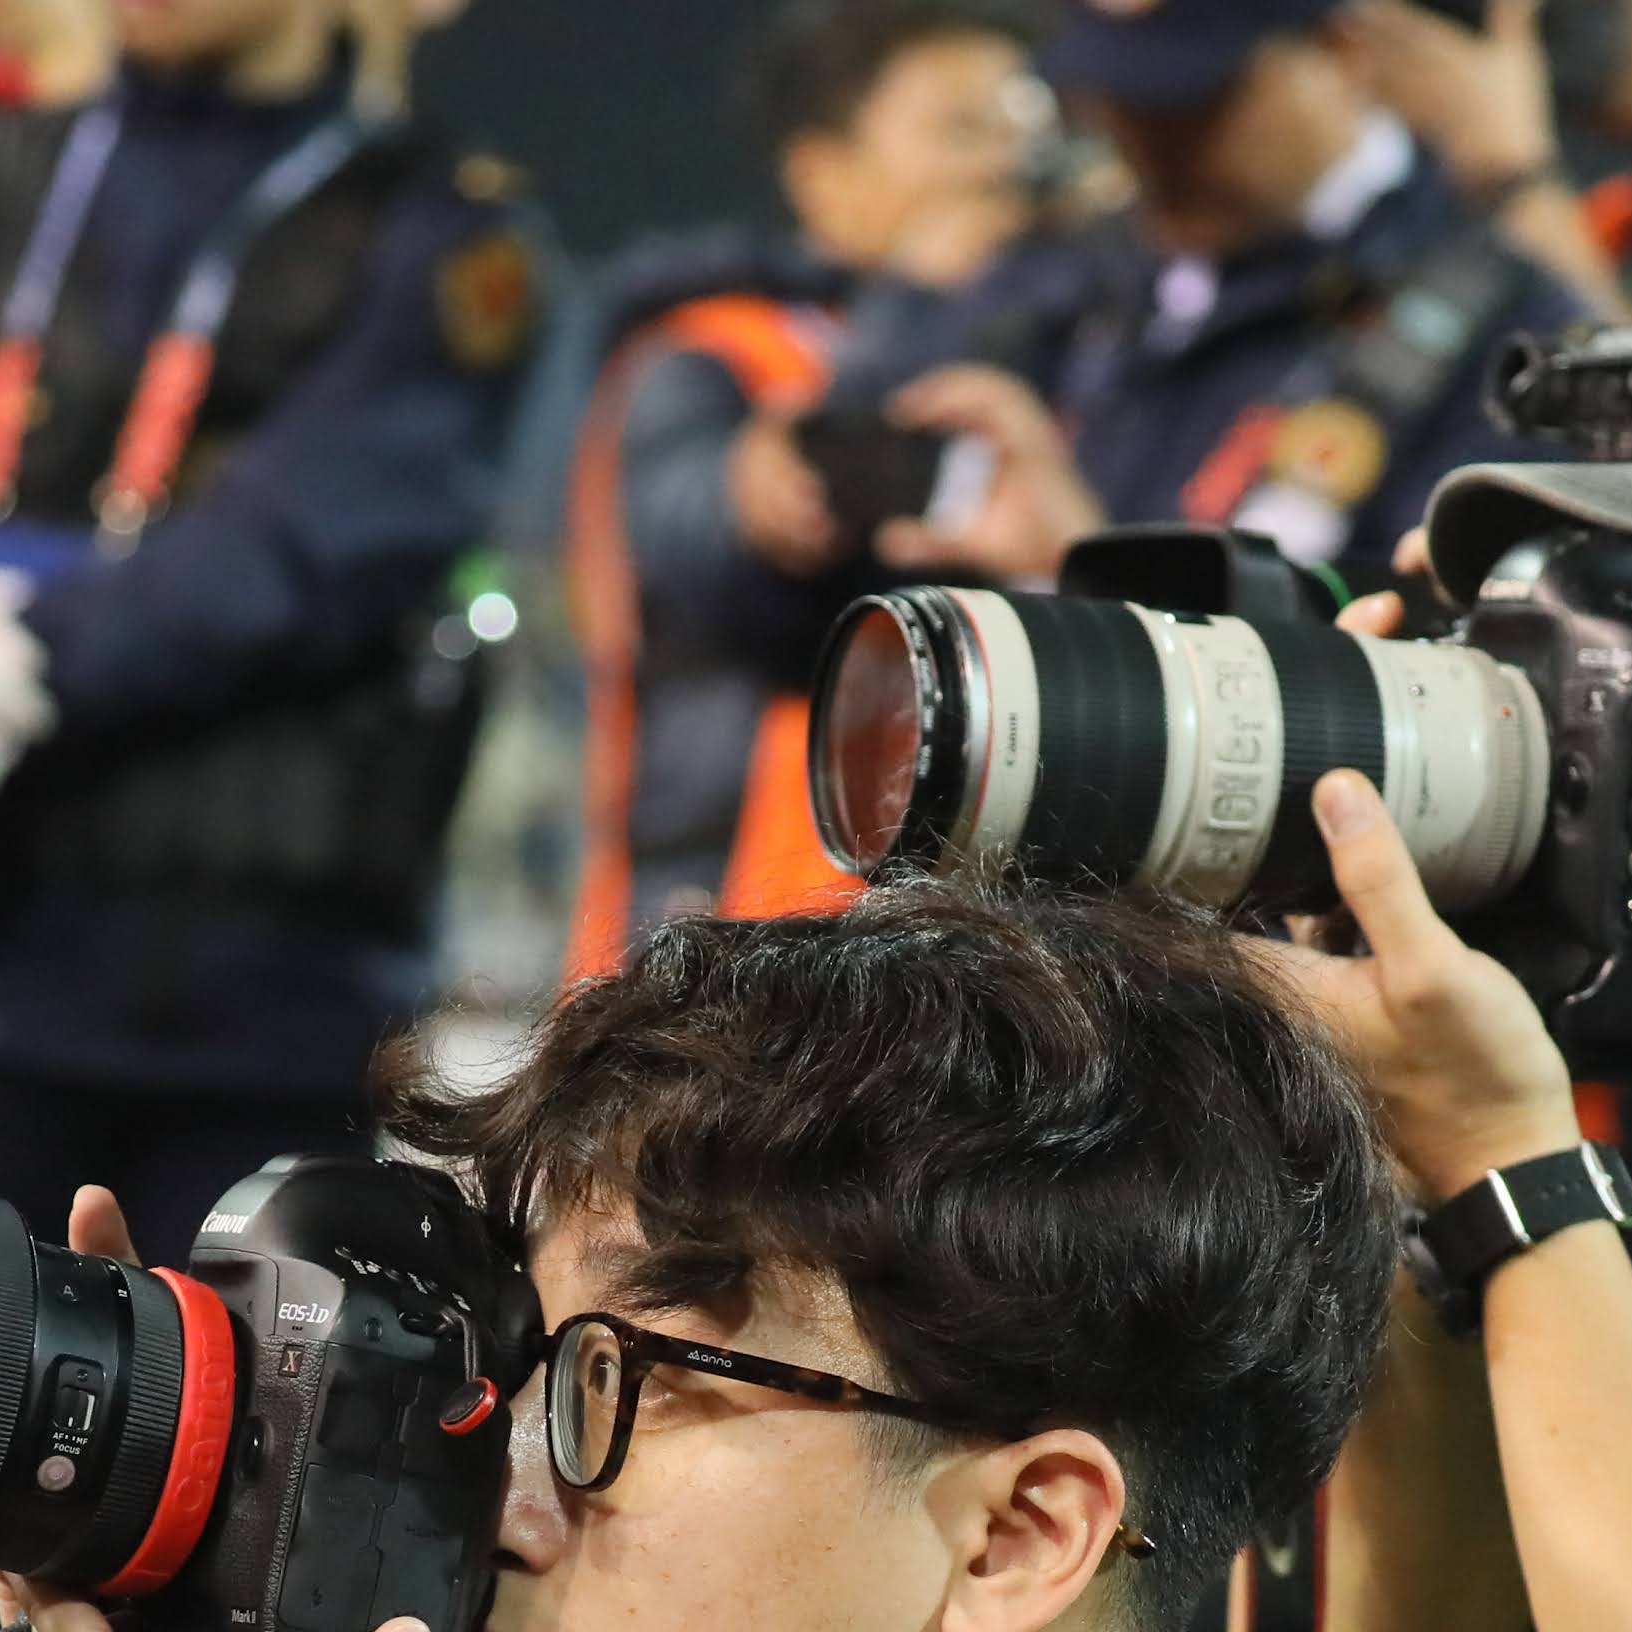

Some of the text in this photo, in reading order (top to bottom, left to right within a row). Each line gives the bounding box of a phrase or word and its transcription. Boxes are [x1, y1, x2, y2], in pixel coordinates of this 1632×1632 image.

[201, 1211, 249, 1234] Canon
[278, 1303, 330, 1324] EOS-1D
[282, 1351, 301, 1373] X
[52, 1431, 89, 1446] AF MF
[53, 1443, 82, 1456] FOCUS
